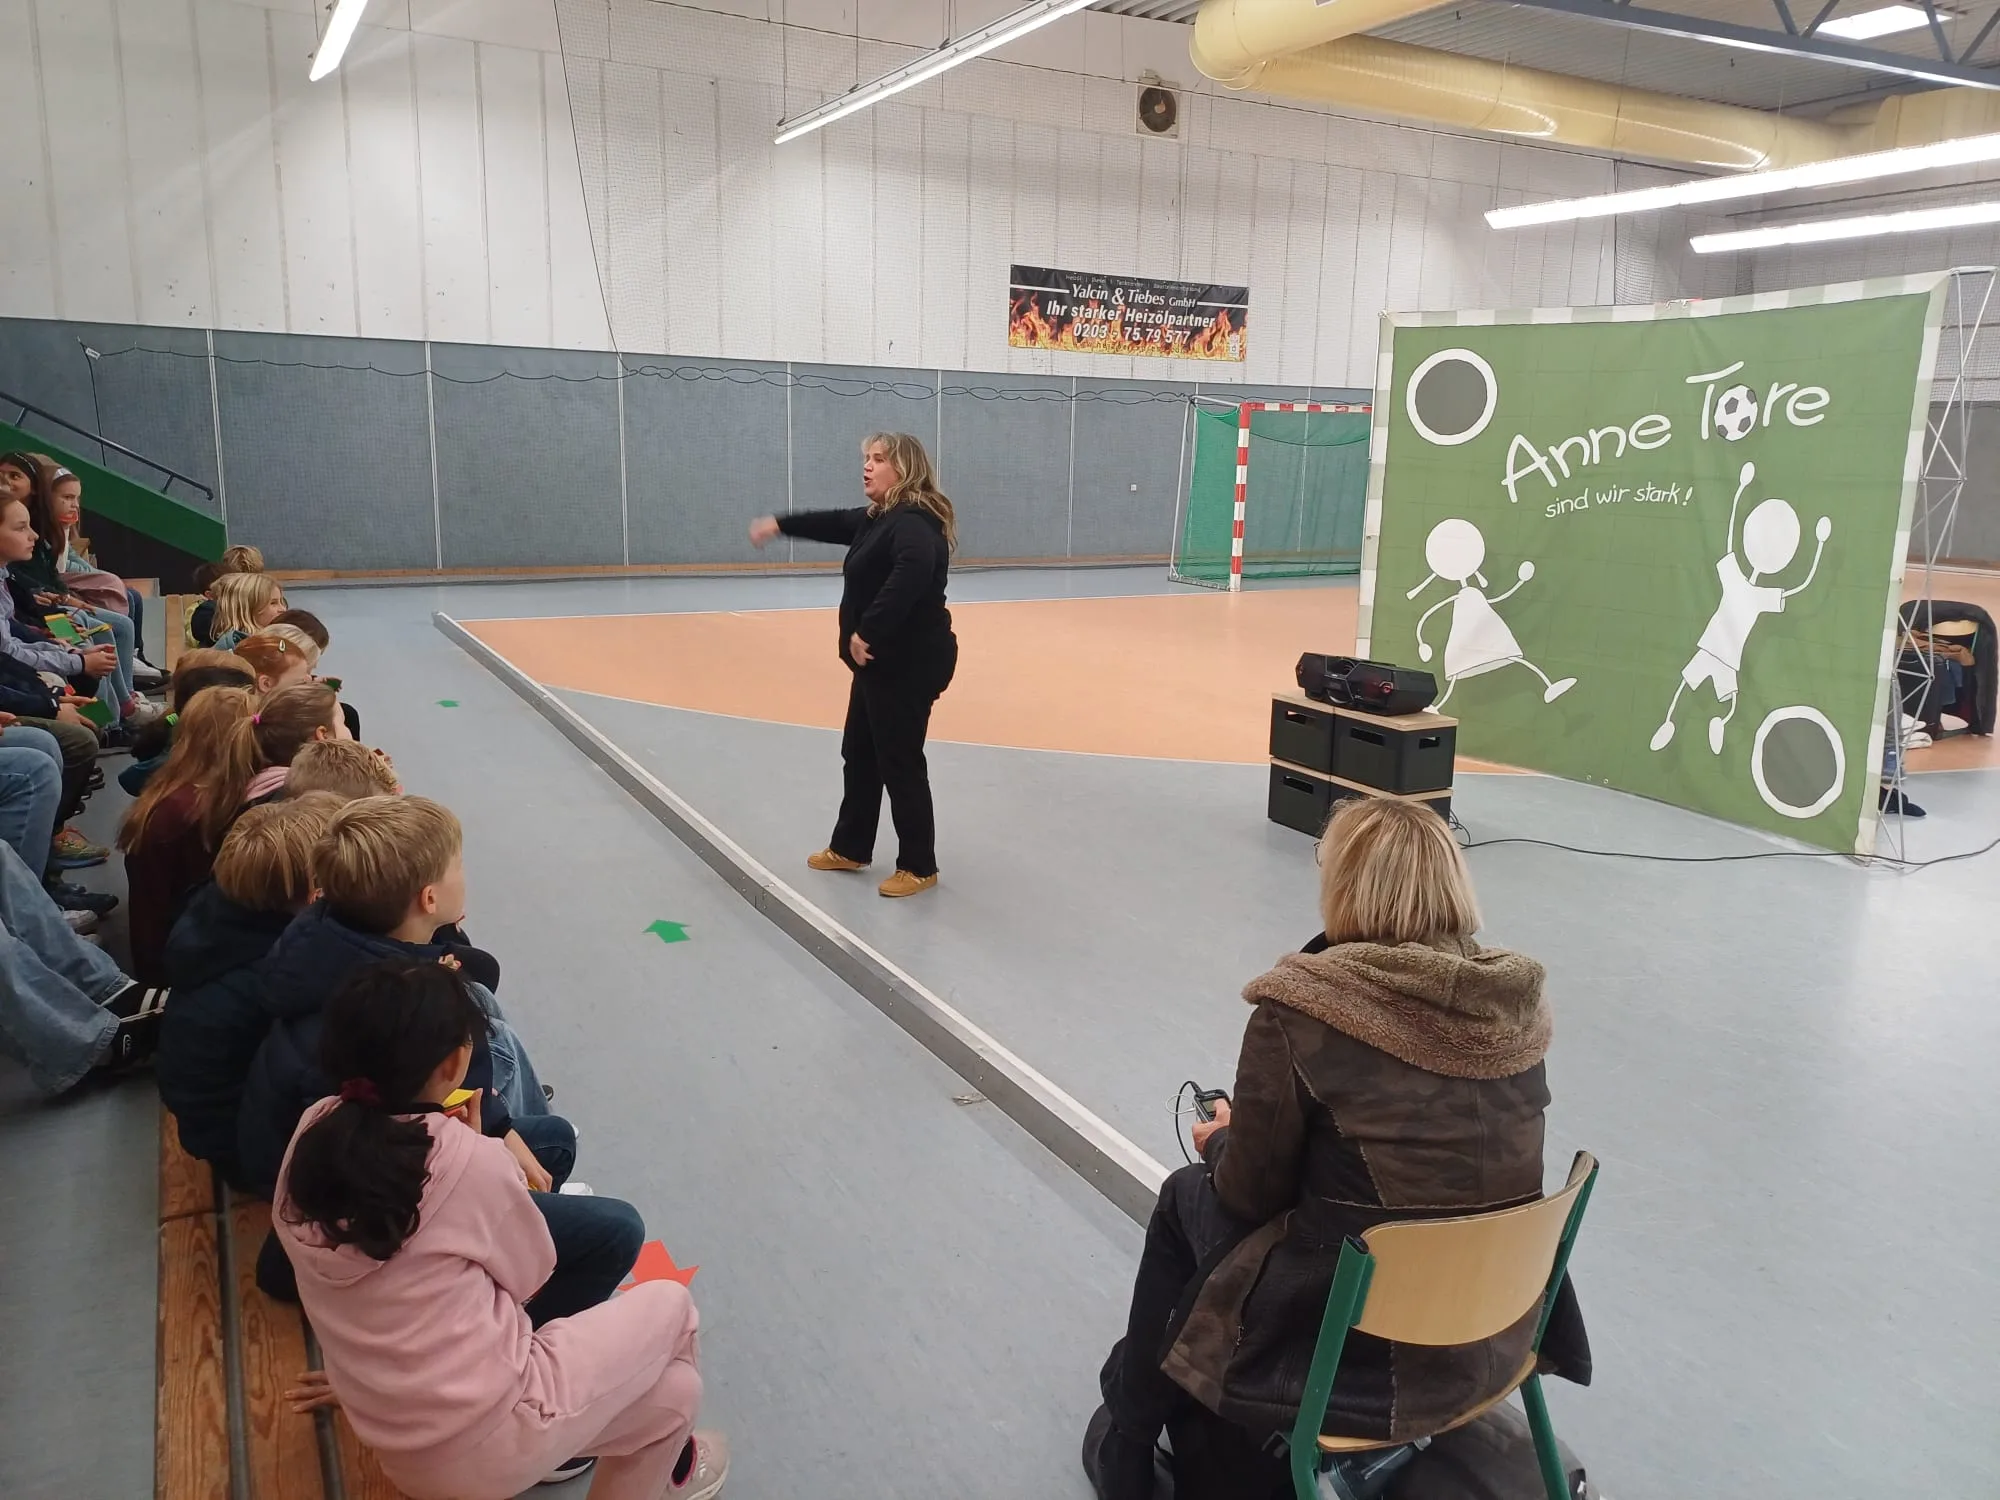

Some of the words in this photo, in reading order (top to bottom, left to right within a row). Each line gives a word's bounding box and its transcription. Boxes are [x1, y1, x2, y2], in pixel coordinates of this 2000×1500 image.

[1072, 283, 1108, 300] Yalcin
[1111, 288, 1125, 305] &
[1128, 289, 1165, 305] Tiebes
[1169, 297, 1196, 308] GmbH
[1046, 300, 1068, 316] Ihr
[1071, 305, 1122, 321] starker
[1125, 308, 1216, 328] Heizölpartner
[1073, 323, 1108, 338] 0203
[1124, 327, 1141, 341] 75
[1145, 329, 1161, 343] 79
[1165, 330, 1191, 344] 577
[1501, 413, 1672, 503] Anne
[1685, 361, 1830, 442] Tore
[1545, 488, 1588, 518] sind
[1596, 485, 1631, 504] wir
